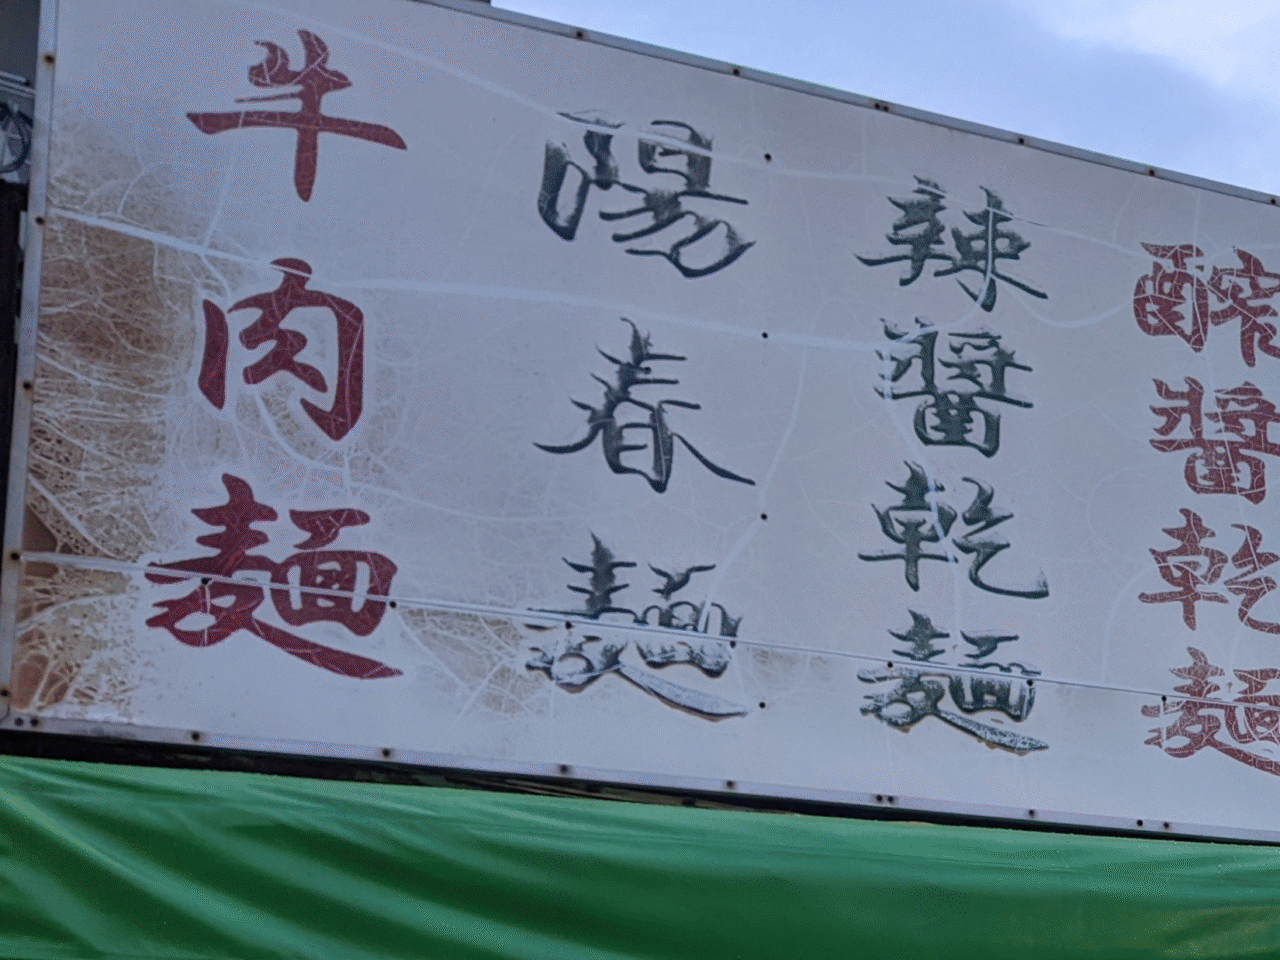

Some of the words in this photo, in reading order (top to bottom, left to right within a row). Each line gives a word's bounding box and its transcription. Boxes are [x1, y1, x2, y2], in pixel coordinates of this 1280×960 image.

[144, 29, 407, 679] 牛肉麵
[525, 110, 757, 722] 陽春麵
[853, 174, 1050, 757] 辣醬乾麵
